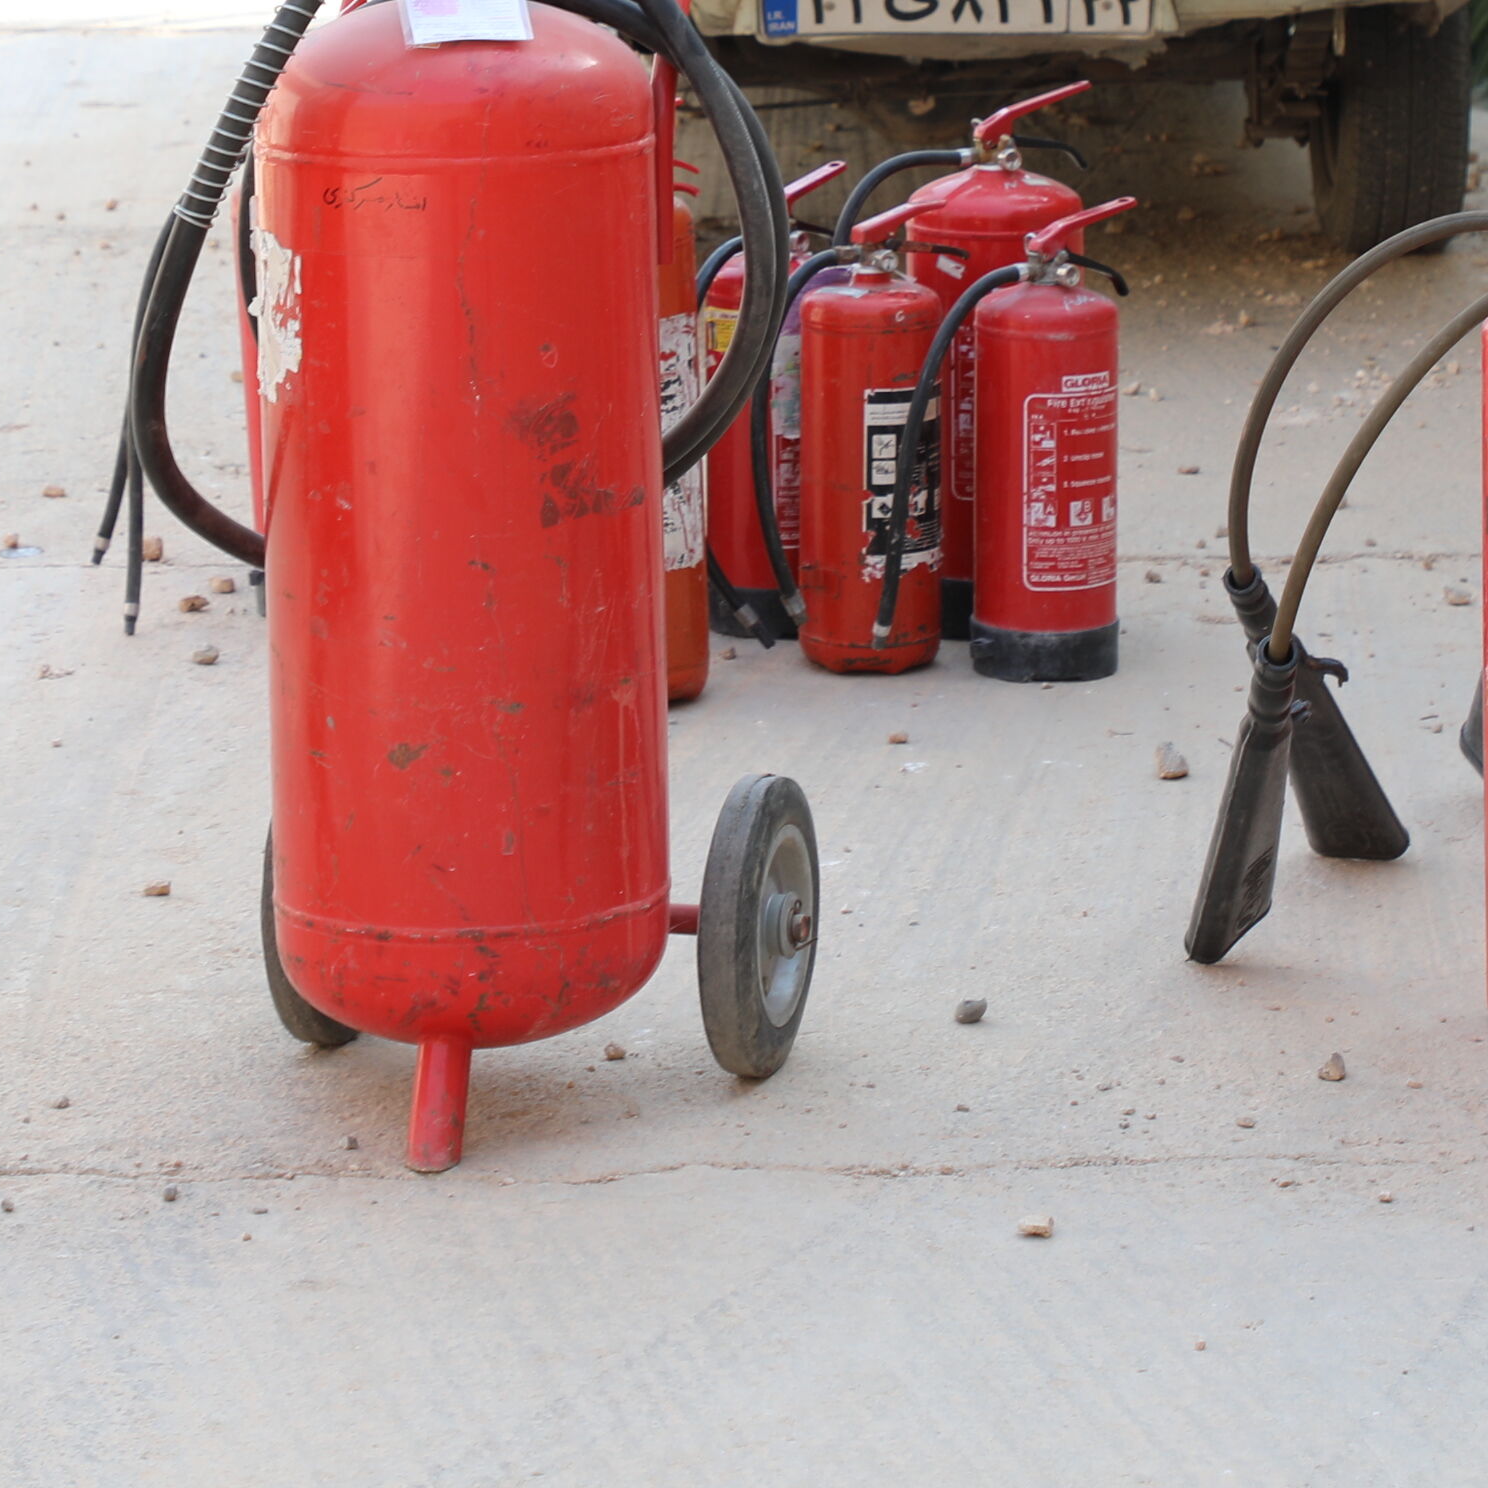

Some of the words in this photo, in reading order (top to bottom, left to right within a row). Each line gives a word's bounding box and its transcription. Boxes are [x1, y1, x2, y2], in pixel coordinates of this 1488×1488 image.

[768, 20, 796, 33] IRAN
[1063, 376, 1108, 389] GLORIA
[1047, 399, 1068, 409] Fire
[1083, 500, 1092, 513] B
